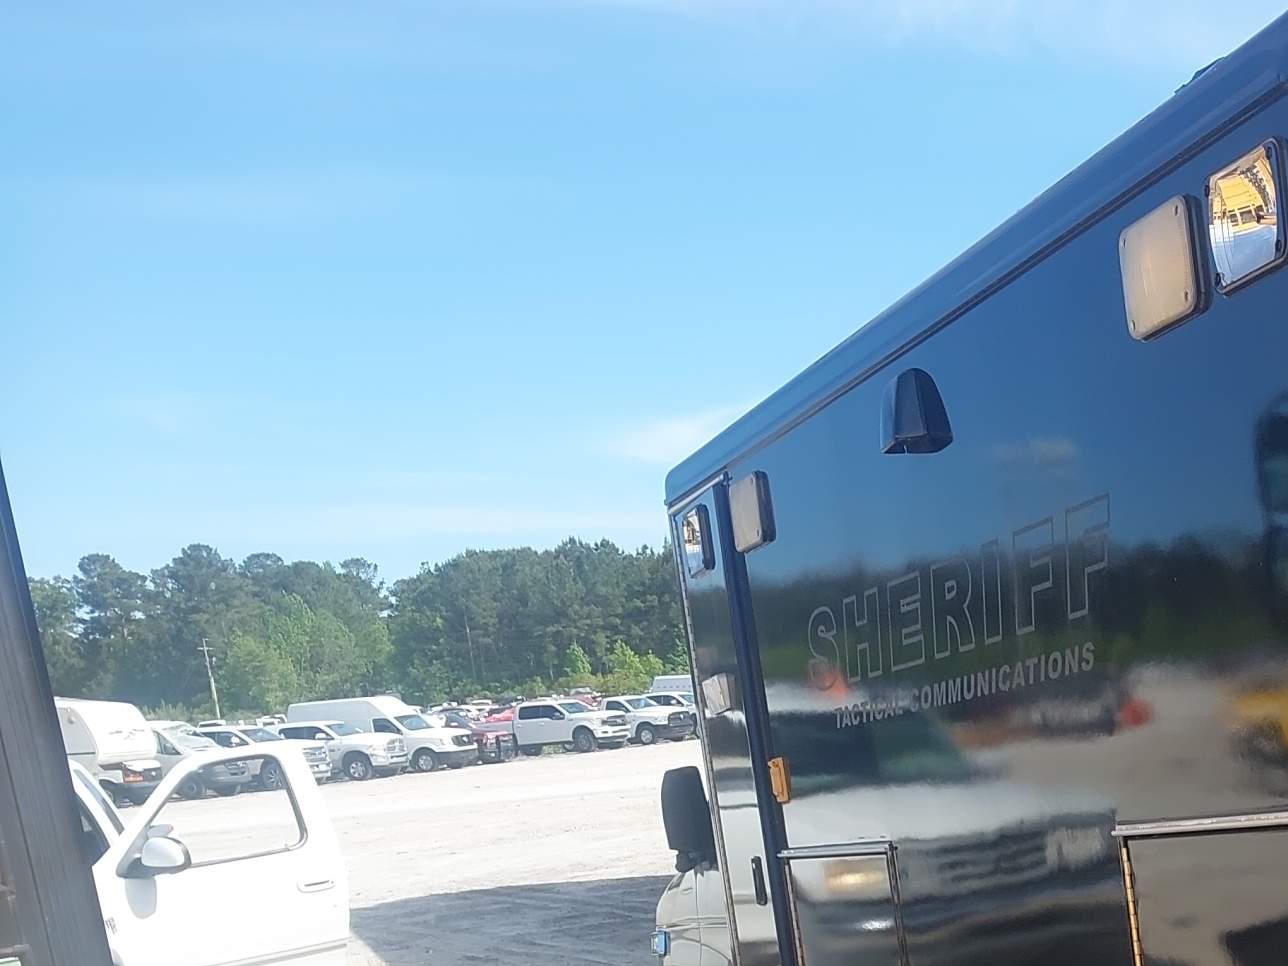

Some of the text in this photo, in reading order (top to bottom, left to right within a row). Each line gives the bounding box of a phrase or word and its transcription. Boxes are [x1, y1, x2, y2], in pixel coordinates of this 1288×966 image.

[807, 492, 1110, 690] SHERIFF
[834, 641, 1095, 729] TACTICAL COMMUNICATIONS
